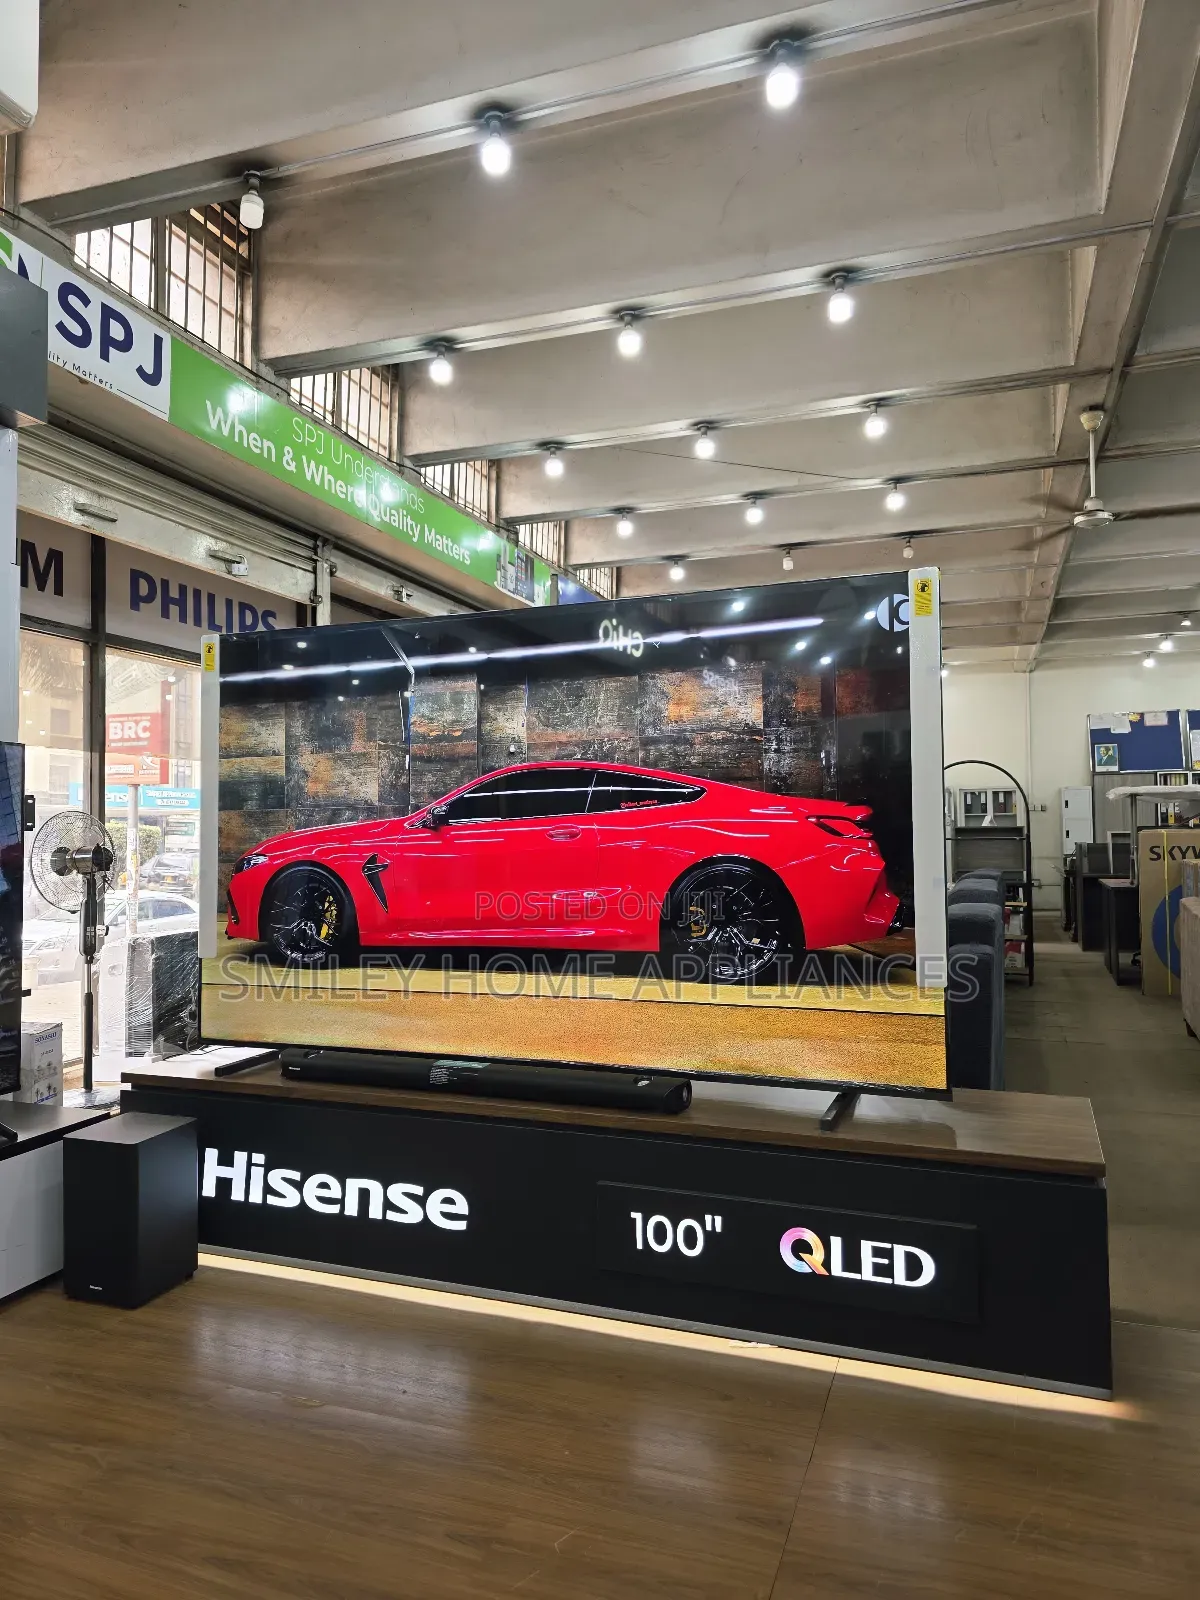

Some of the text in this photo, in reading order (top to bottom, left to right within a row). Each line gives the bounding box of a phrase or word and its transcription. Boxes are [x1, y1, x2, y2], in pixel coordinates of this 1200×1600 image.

[55, 281, 164, 387] SPJ
[72, 362, 113, 390] Matters
[292, 416, 324, 454] SPJ
[205, 399, 471, 566] When & Where Quality Matters
[129, 567, 278, 633] PHILIPS
[108, 720, 151, 740] BRC
[201, 1147, 470, 1232] Hisense
[630, 1211, 936, 1288] 100" QLED
